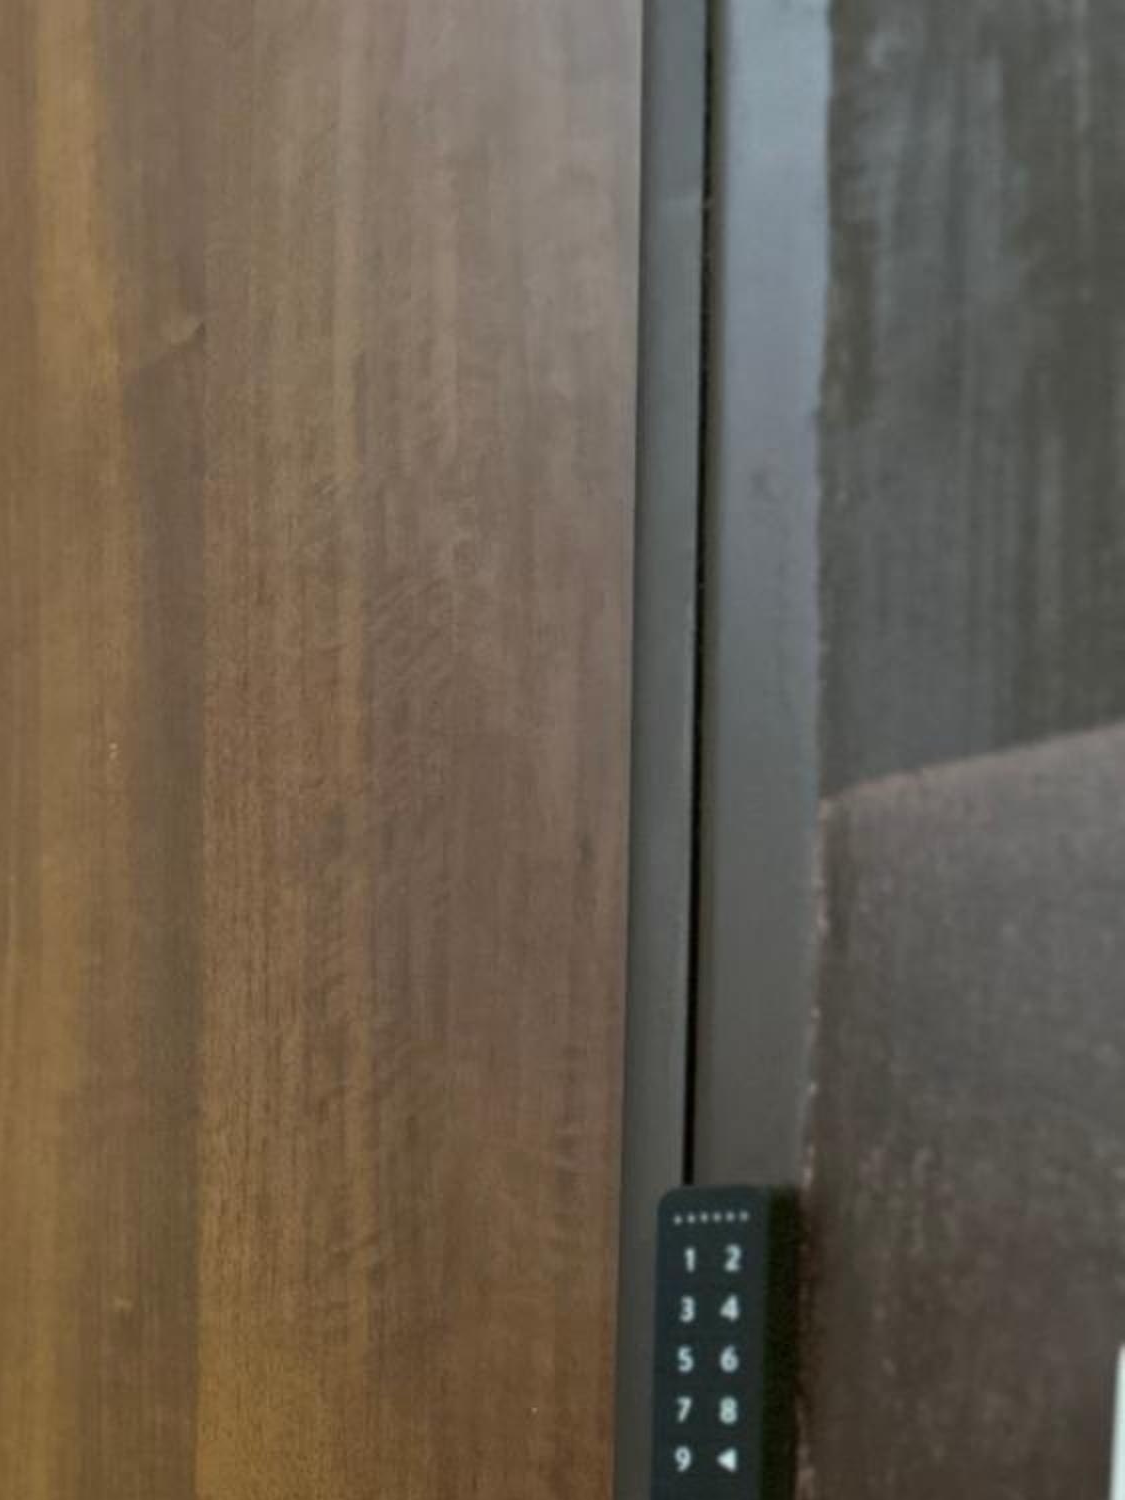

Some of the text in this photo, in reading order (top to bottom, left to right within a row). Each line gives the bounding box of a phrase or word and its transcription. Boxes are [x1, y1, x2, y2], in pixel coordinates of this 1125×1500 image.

[684, 1244, 741, 1273] 1 2
[680, 1295, 739, 1323] 3 4
[677, 1345, 739, 1373] 5 6
[677, 1396, 738, 1424] 7 8
[674, 1446, 692, 1472] 9
